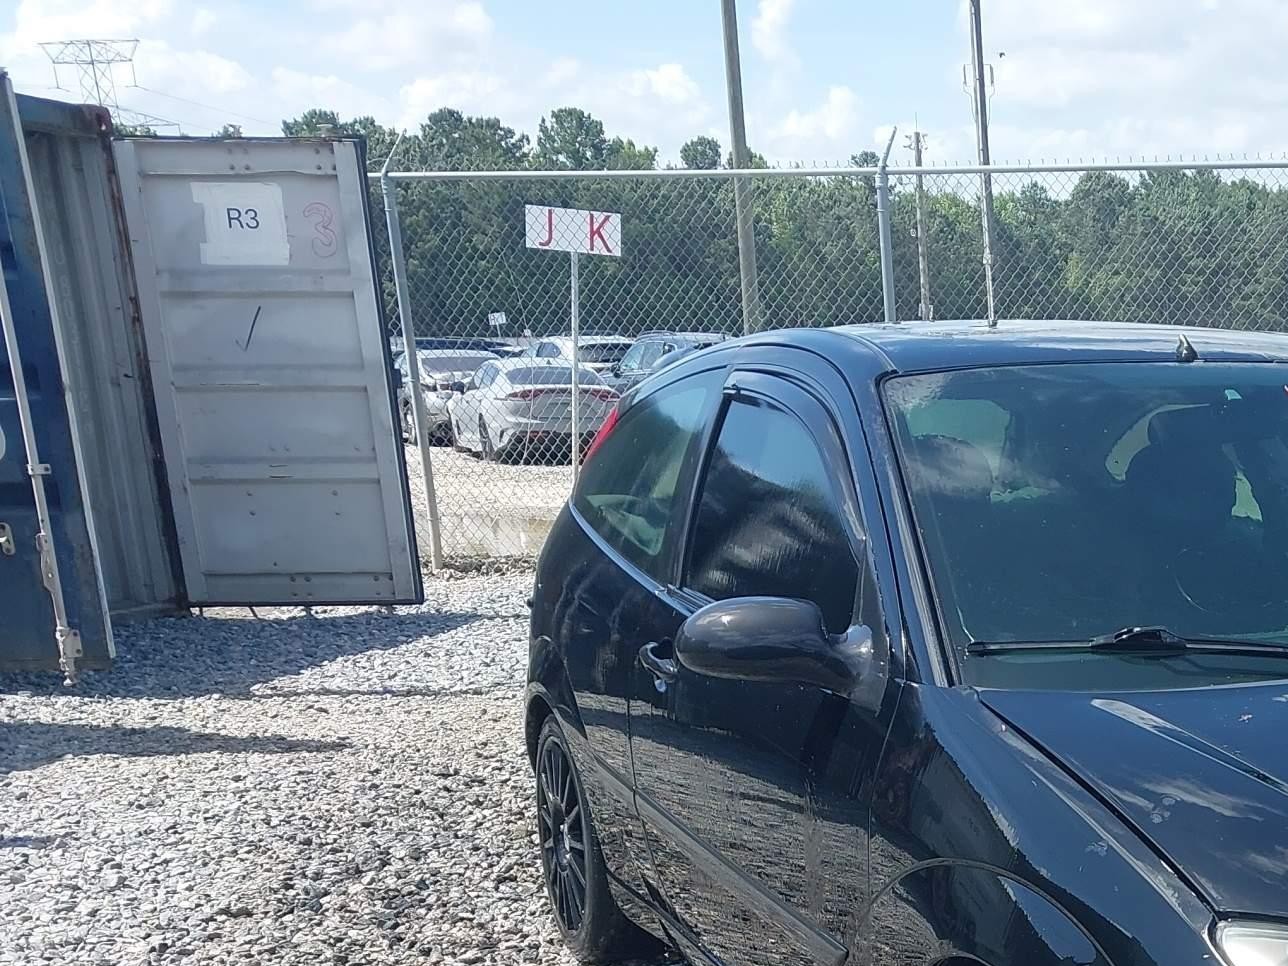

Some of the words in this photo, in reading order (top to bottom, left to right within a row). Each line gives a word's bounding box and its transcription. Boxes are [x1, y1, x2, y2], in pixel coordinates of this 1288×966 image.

[226, 207, 260, 229] R3
[303, 202, 337, 257] 3
[538, 208, 553, 247] J
[589, 212, 613, 253] K
